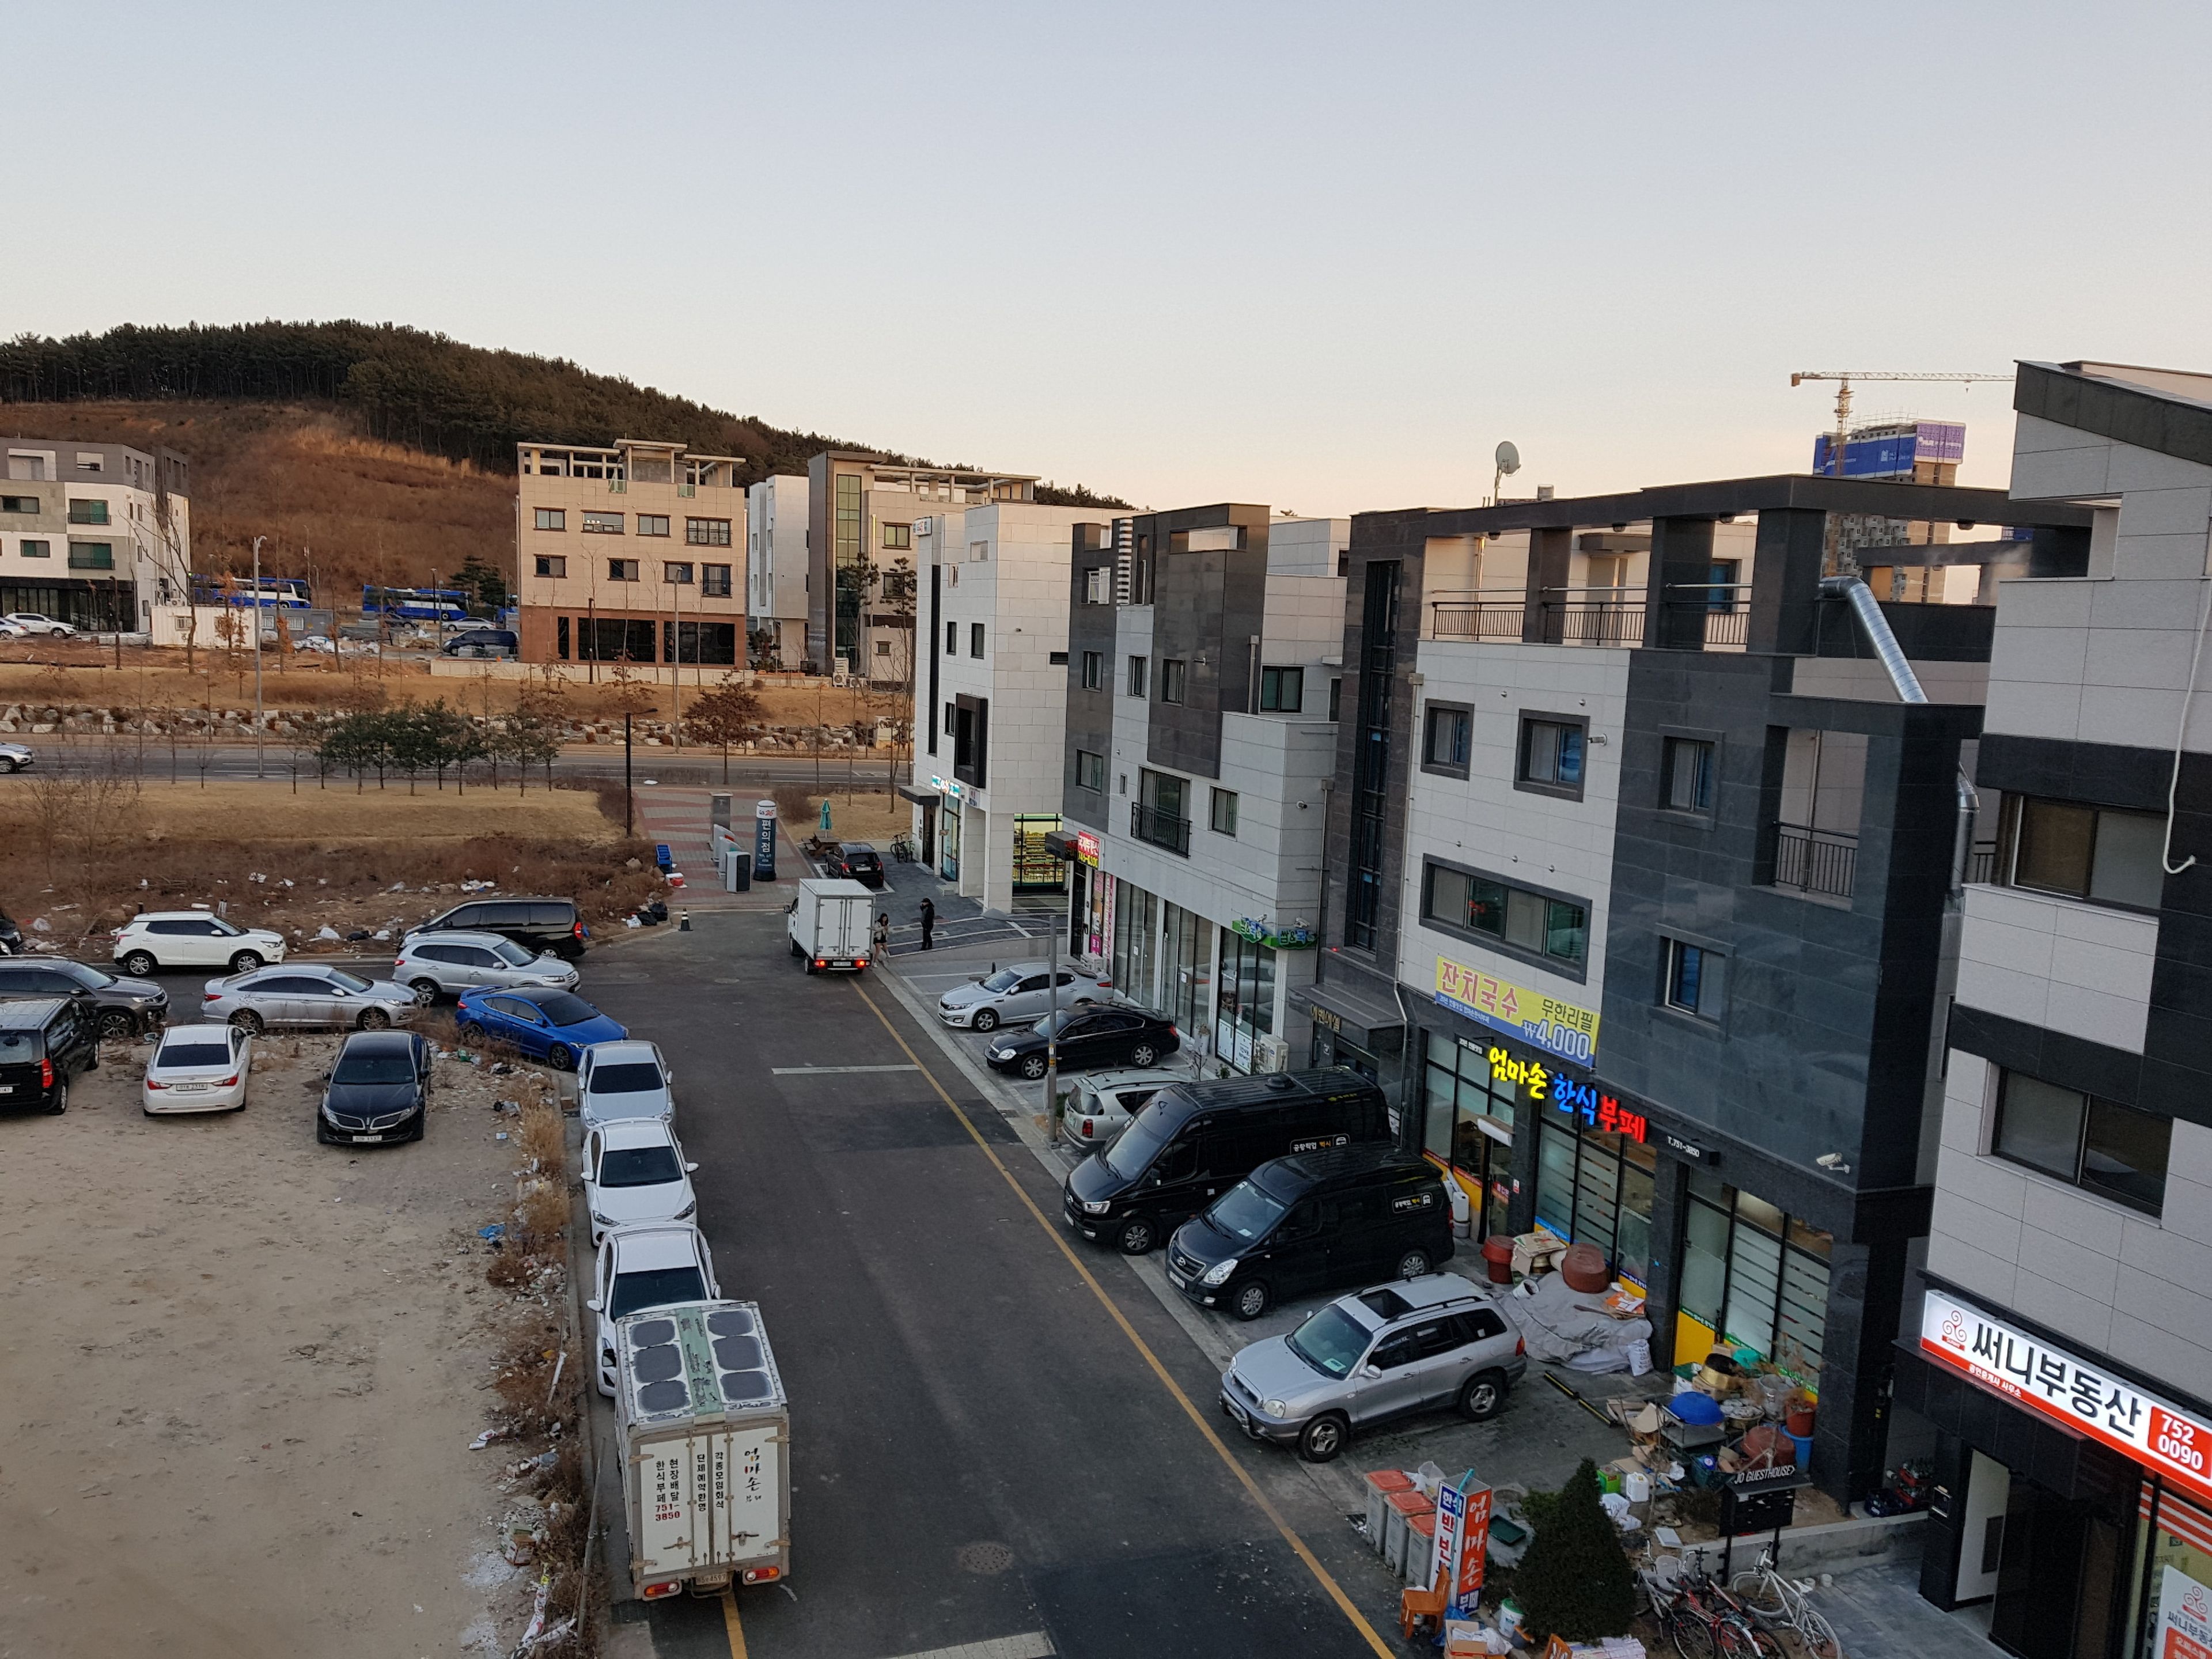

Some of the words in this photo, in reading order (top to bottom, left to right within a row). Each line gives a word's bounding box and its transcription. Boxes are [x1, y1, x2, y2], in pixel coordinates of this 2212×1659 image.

[761, 819, 771, 853] 편의점
[1441, 961, 1519, 1019] 잔치국수
[1541, 998, 1594, 1033] 무한리필
[1488, 1047, 1547, 1100] 엄마손
[1553, 1072, 1597, 1126] 한식
[1598, 1095, 1647, 1144] 부페
[1968, 1363, 2001, 1387] 공인중개사
[2001, 1381, 2022, 1398] 사무소
[1971, 1323, 2142, 1439] 써니부동산
[2161, 1413, 2195, 1446] 752
[2158, 1434, 2204, 1470] 0090
[656, 1460, 666, 1503] 한식부페
[669, 1458, 680, 1502] 현장배달
[1734, 1472, 1745, 1484] JO
[655, 1510, 680, 1521] 3850
[1462, 1494, 1488, 1587] 엄마손
